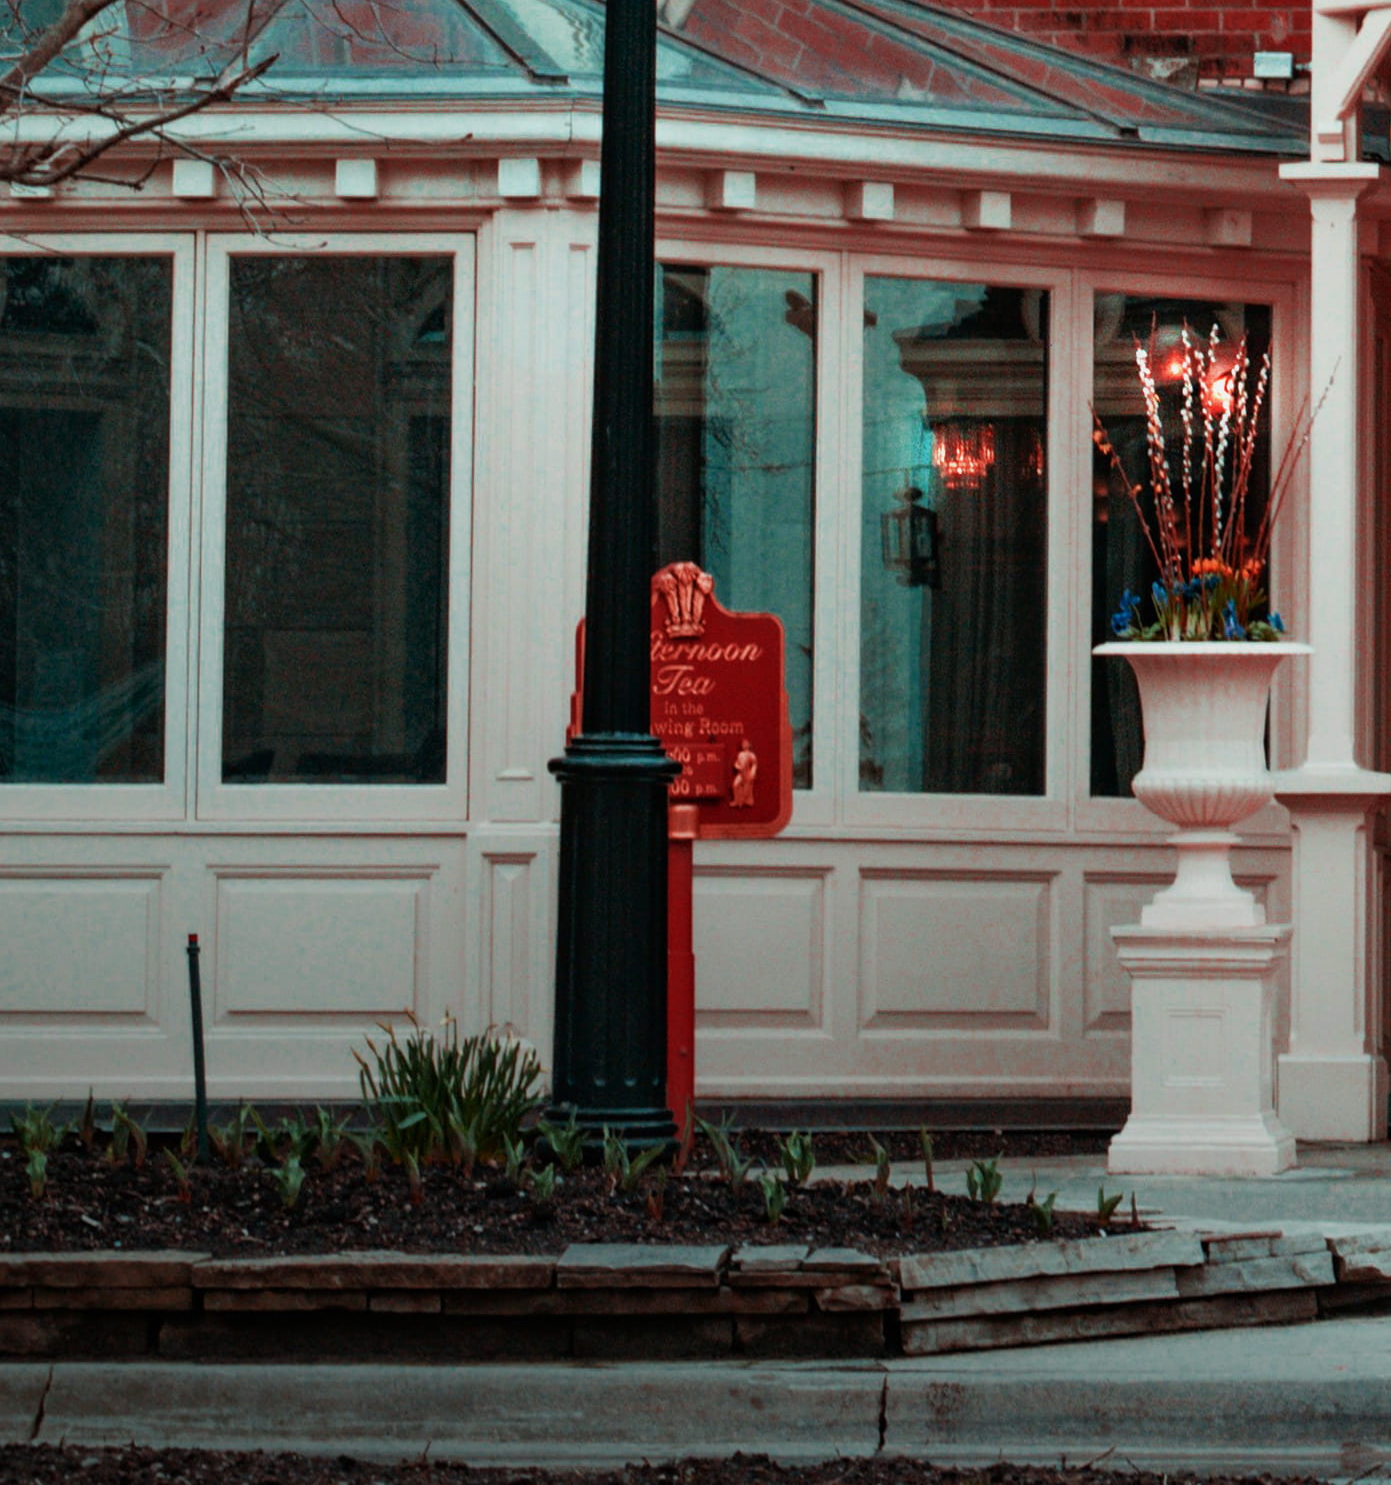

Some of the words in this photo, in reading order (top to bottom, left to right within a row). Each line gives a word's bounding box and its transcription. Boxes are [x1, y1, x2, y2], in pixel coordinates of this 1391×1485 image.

[653, 665, 716, 695] Tea
[664, 700, 678, 715] in
[682, 701, 704, 715] the
[651, 718, 694, 738] wing
[700, 717, 744, 735] Room
